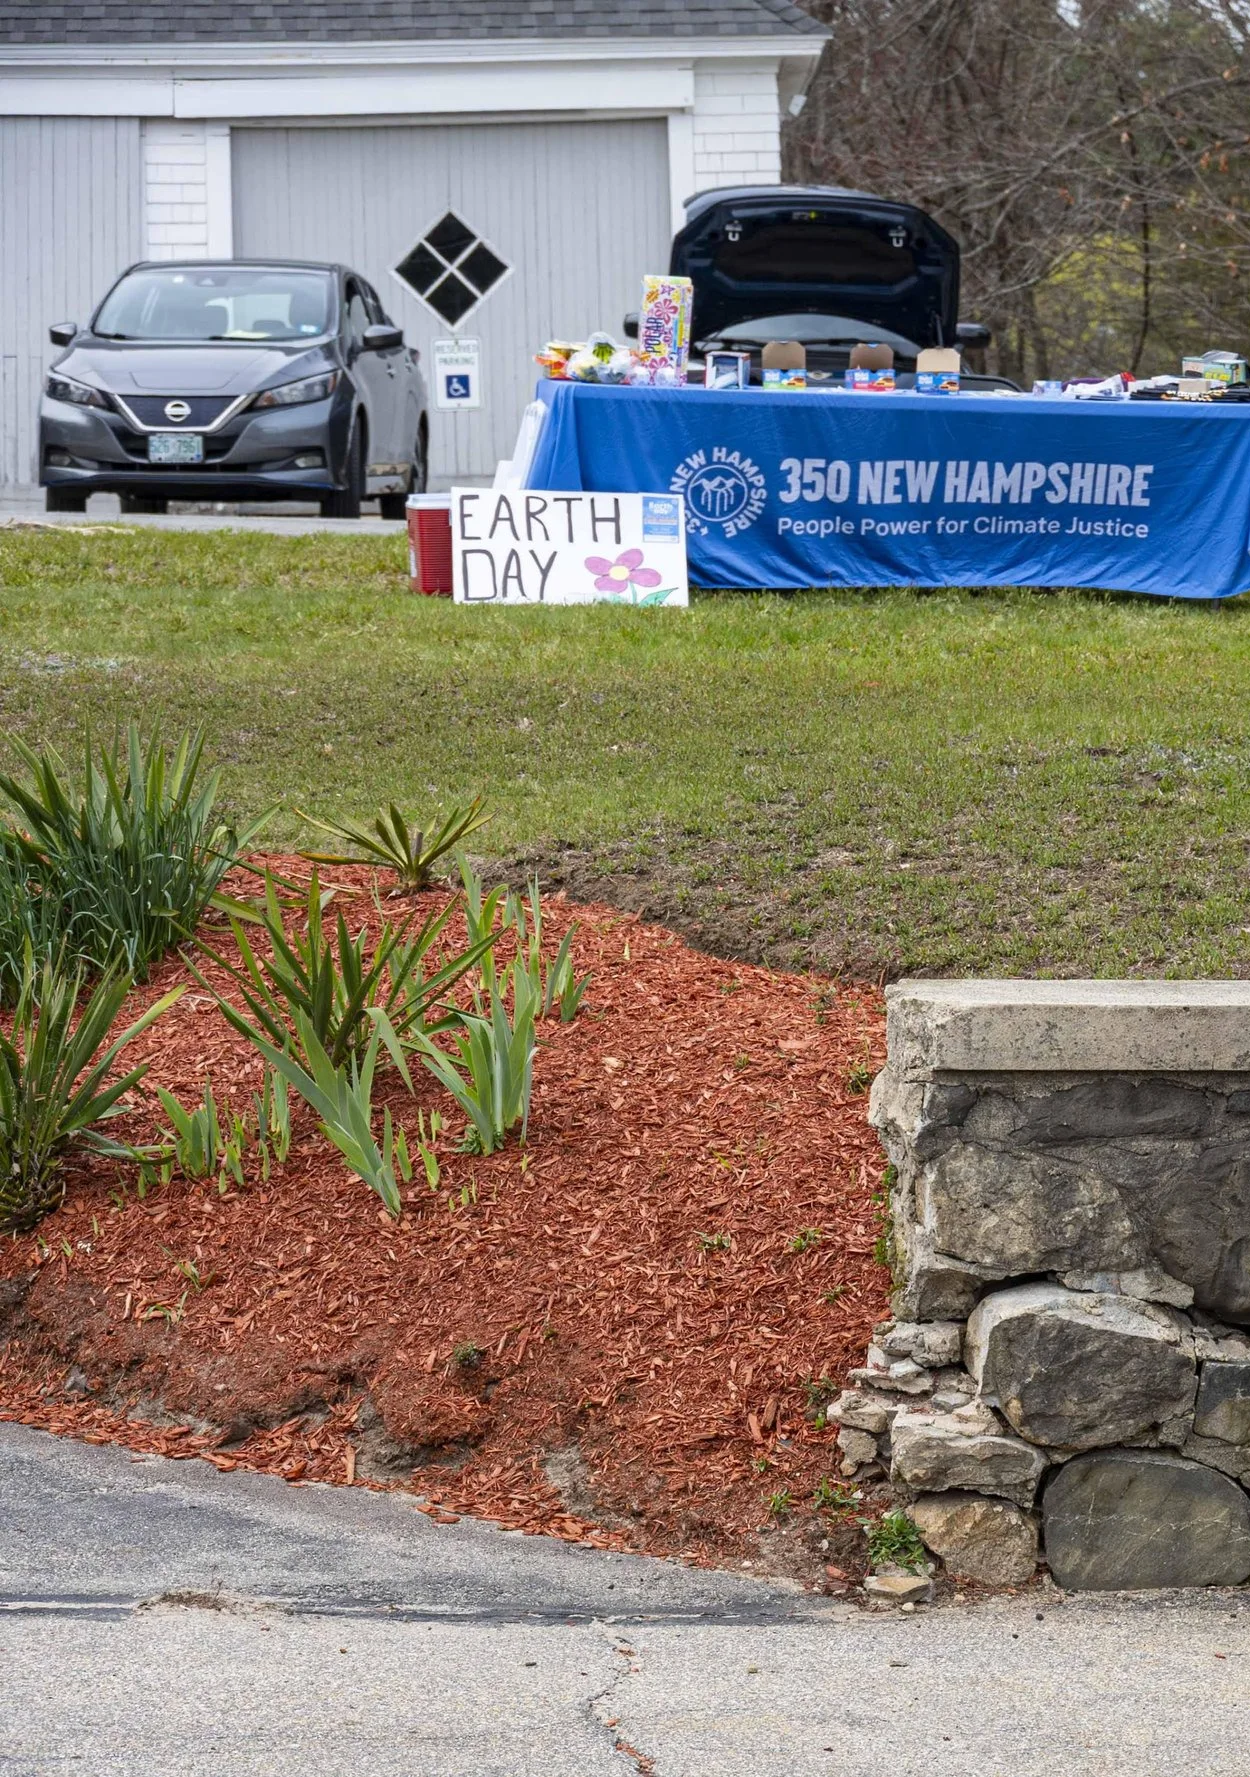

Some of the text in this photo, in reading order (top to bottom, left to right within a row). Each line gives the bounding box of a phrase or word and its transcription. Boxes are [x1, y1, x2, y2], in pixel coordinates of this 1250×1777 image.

[644, 316, 665, 354] POLAR
[669, 447, 768, 538] NEW HAMPSHIRE
[778, 457, 1154, 507] 350 NEW HAMPSHIRE
[459, 494, 622, 544] EARTH
[778, 516, 1149, 538] People Power for Climate Justice
[462, 548, 558, 601] DAY
